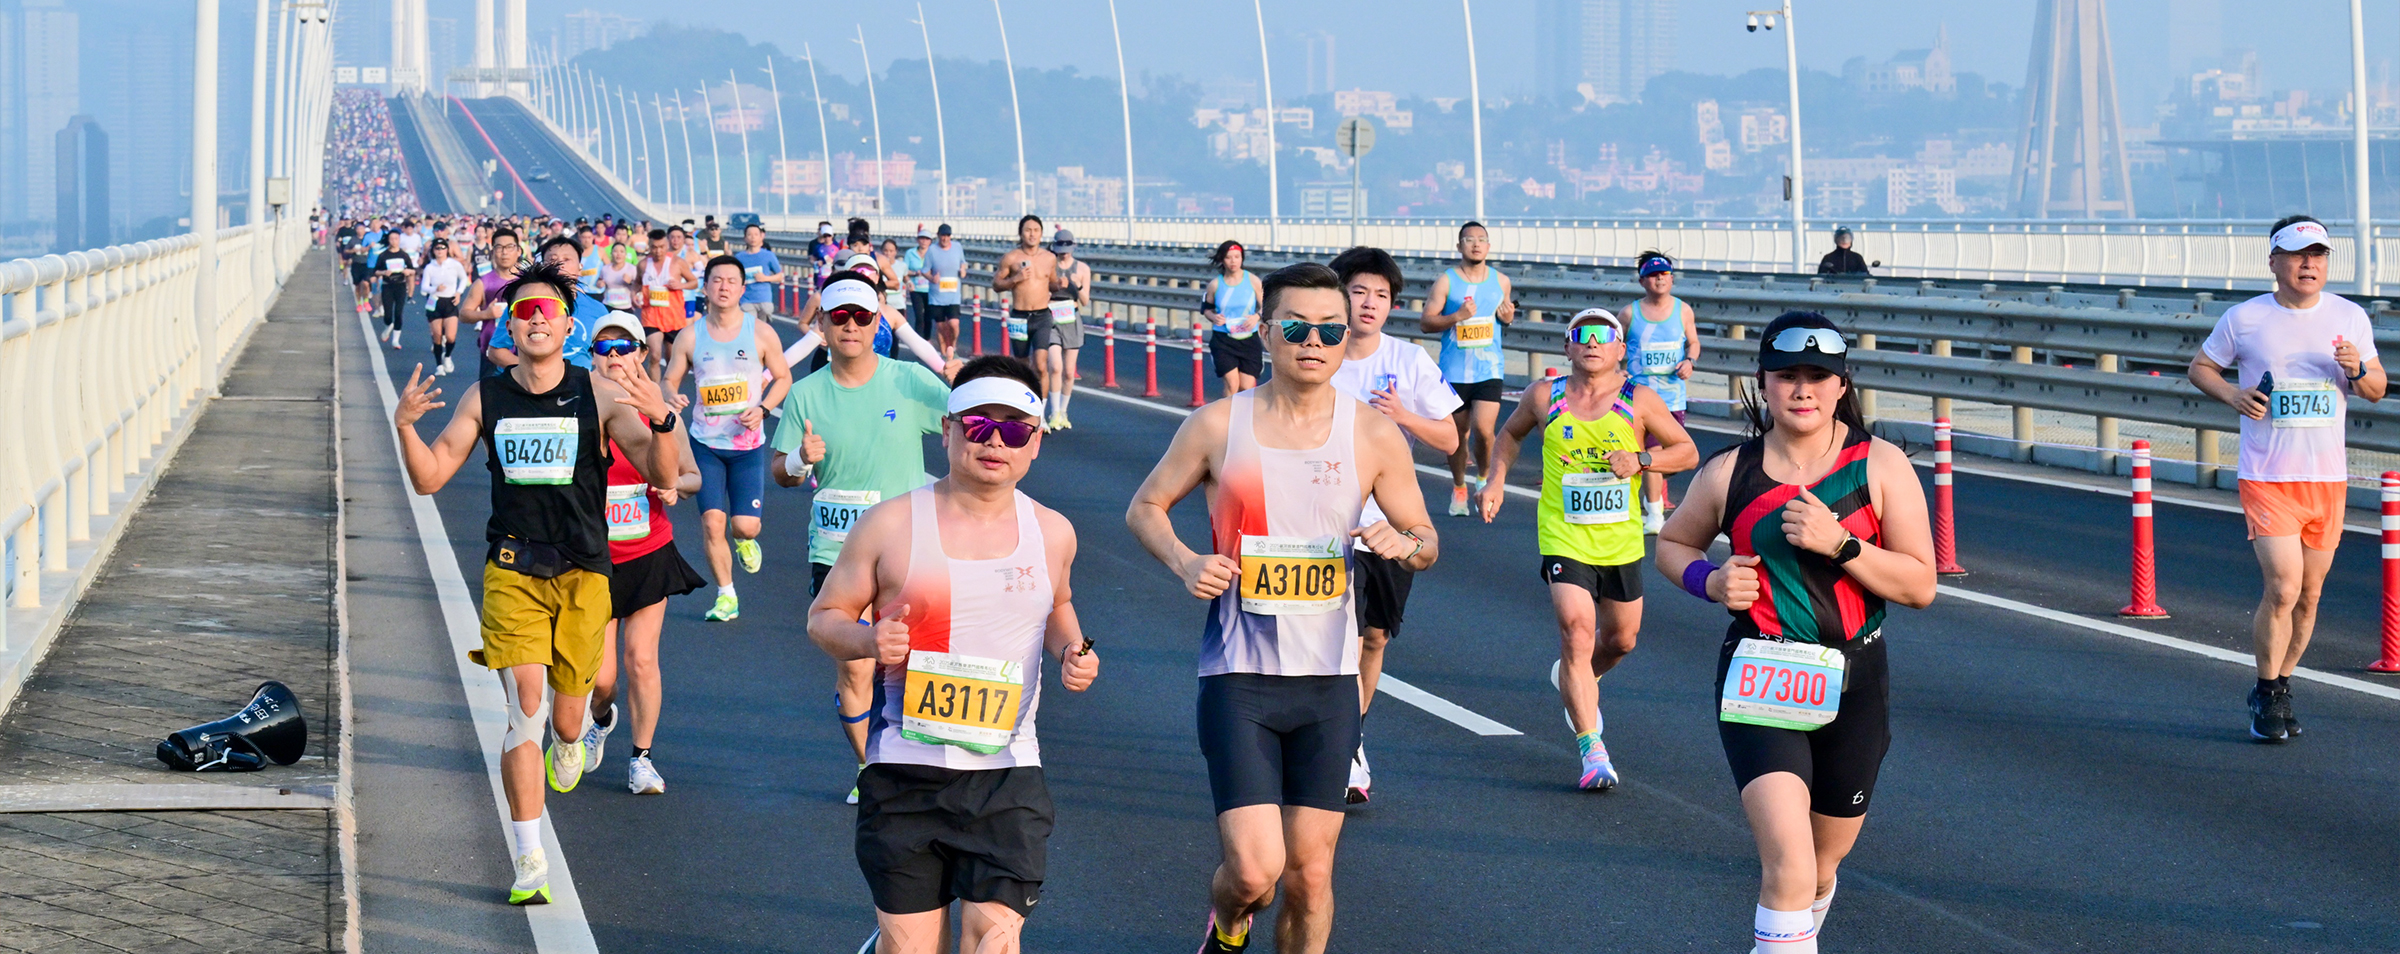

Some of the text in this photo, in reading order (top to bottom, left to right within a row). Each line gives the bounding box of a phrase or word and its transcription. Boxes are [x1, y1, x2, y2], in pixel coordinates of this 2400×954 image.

[1462, 326, 1491, 340] A2078
[1646, 352, 1677, 366] B5764
[707, 385, 743, 405] A4399
[2279, 394, 2331, 416] B5743
[504, 438, 568, 464] B4264
[1571, 489, 1624, 512] B6063
[820, 506, 867, 530] B491
[1254, 563, 1336, 596] A3108
[1738, 663, 1827, 707] B7300
[917, 680, 1009, 725] A3117
